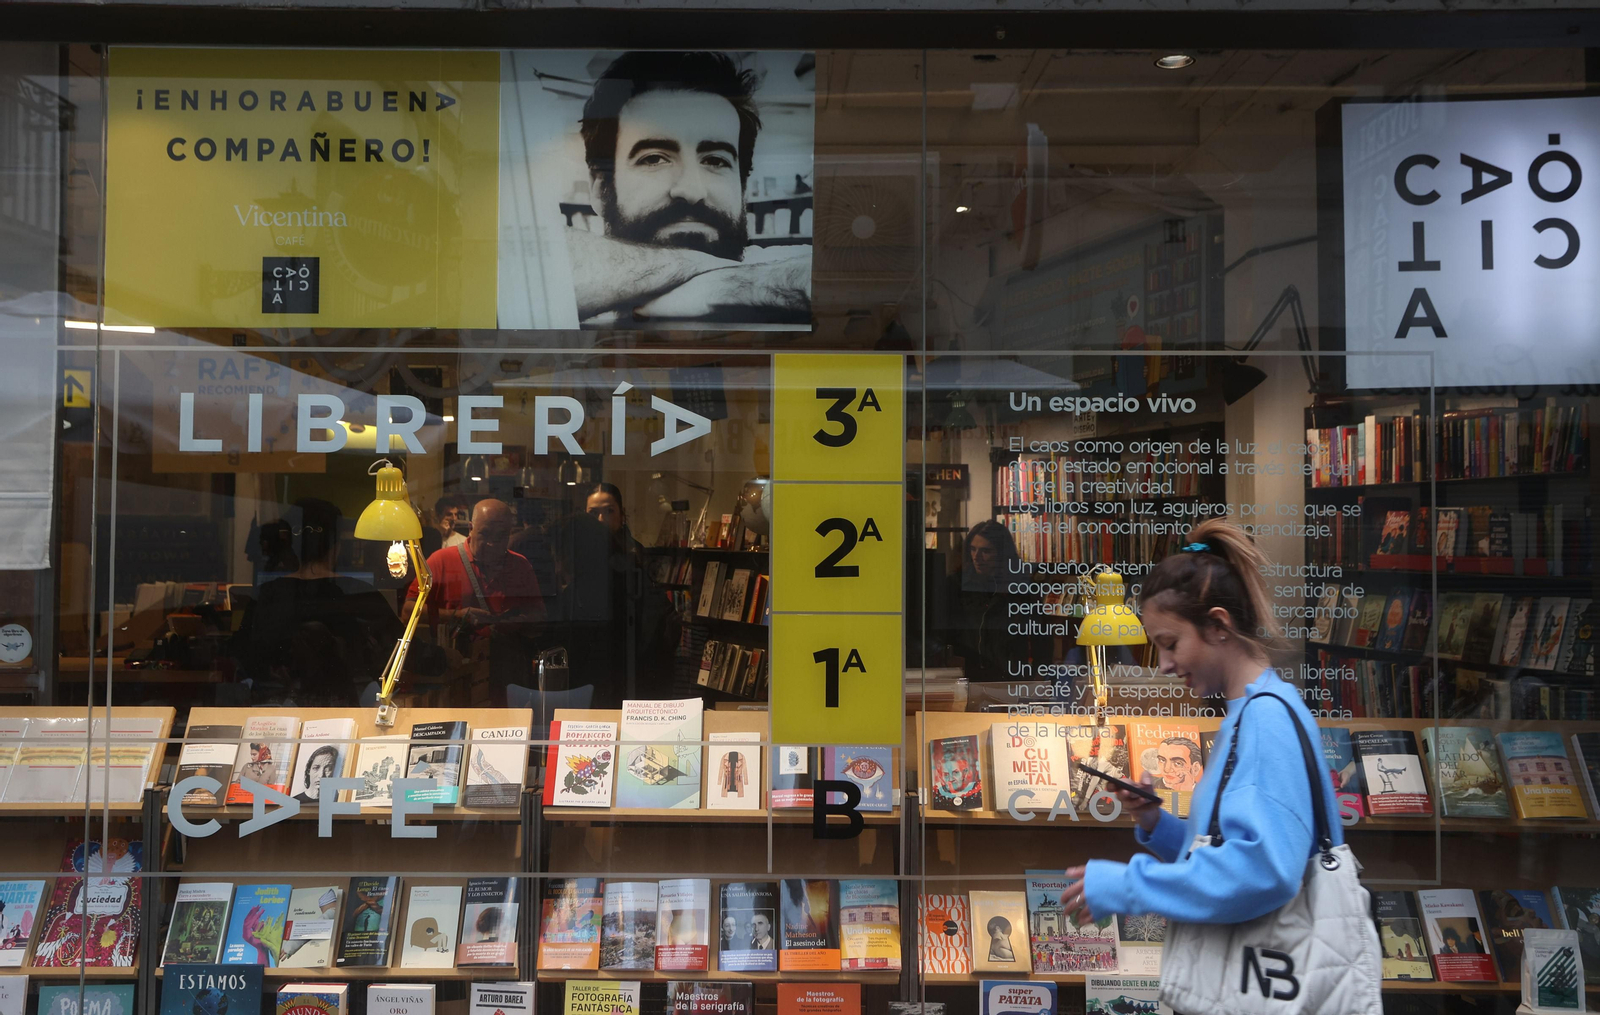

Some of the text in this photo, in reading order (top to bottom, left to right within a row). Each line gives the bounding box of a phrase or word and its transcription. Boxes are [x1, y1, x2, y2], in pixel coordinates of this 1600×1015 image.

[137, 88, 456, 112] ¡ENHORABUENA
[166, 132, 431, 162] COMPAÑERO!
[233, 204, 348, 228] Vicentina
[275, 234, 306, 246] CAFÉ
[1009, 392, 1197, 416] Un espacio vivo
[179, 381, 712, 457] LIBRERÍA
[1009, 437, 1024, 452] El
[1030, 440, 1069, 454] caos
[1074, 440, 1124, 454] como
[1129, 438, 1183, 457] origen
[1188, 438, 1211, 454] de
[1216, 439, 1230, 454] la
[1268, 440, 1282, 455] el
[1008, 458, 1356, 476] como estado emocional a través del cual
[1008, 478, 1176, 495] surge la creatividad.
[1009, 498, 1362, 519] Los libros son luz, agujeros por los que se
[1008, 518, 1192, 535] cuela el conocimiento
[1008, 558, 1033, 575] Un
[1038, 559, 1089, 575] sueño
[1258, 562, 1343, 578] estructura
[1008, 580, 1126, 598] cooperativista
[1274, 582, 1365, 599] sentido de
[1008, 602, 1107, 617] pertenencia
[1273, 603, 1359, 619] tercambio
[1008, 620, 1113, 638] cultural y de
[1008, 660, 1160, 680] Un espacio vivo y
[1300, 663, 1358, 682] librería,
[1008, 685, 1030, 697] un
[1035, 680, 1071, 697] café
[1076, 685, 1088, 700] y
[1092, 685, 1114, 698] un
[1118, 683, 1185, 701] espacio
[668, 714, 687, 722] CHING
[1008, 702, 1216, 719] para el fomento del libro
[481, 729, 523, 739] CANIJO
[1008, 722, 1114, 738] de la lectura.
[1136, 724, 1198, 740] Federico
[1024, 748, 1048, 760] CU
[1013, 760, 1051, 773] MEN
[1025, 773, 1057, 786] TAL
[1523, 787, 1572, 795] Una librería
[813, 780, 864, 839] B
[255, 887, 279, 895] Judith
[1032, 881, 1067, 889] Reportaje
[864, 927, 891, 935] librería
[1502, 929, 1519, 938] bell
[179, 974, 246, 990] ESTAMOS
[1091, 979, 1122, 987] DIBUJANDO
[374, 994, 424, 1004] ÁNGEL VIÑAS
[479, 994, 523, 1004] ARTURO BAREA
[571, 992, 633, 1003] FOTOGRAFÍA
[676, 992, 719, 1001] Maestros
[1008, 987, 1033, 996] super
[571, 1002, 633, 1014] FANTÁSTICA
[675, 1001, 745, 1013] de la serigrafía
[998, 995, 1043, 1006] PATATA
